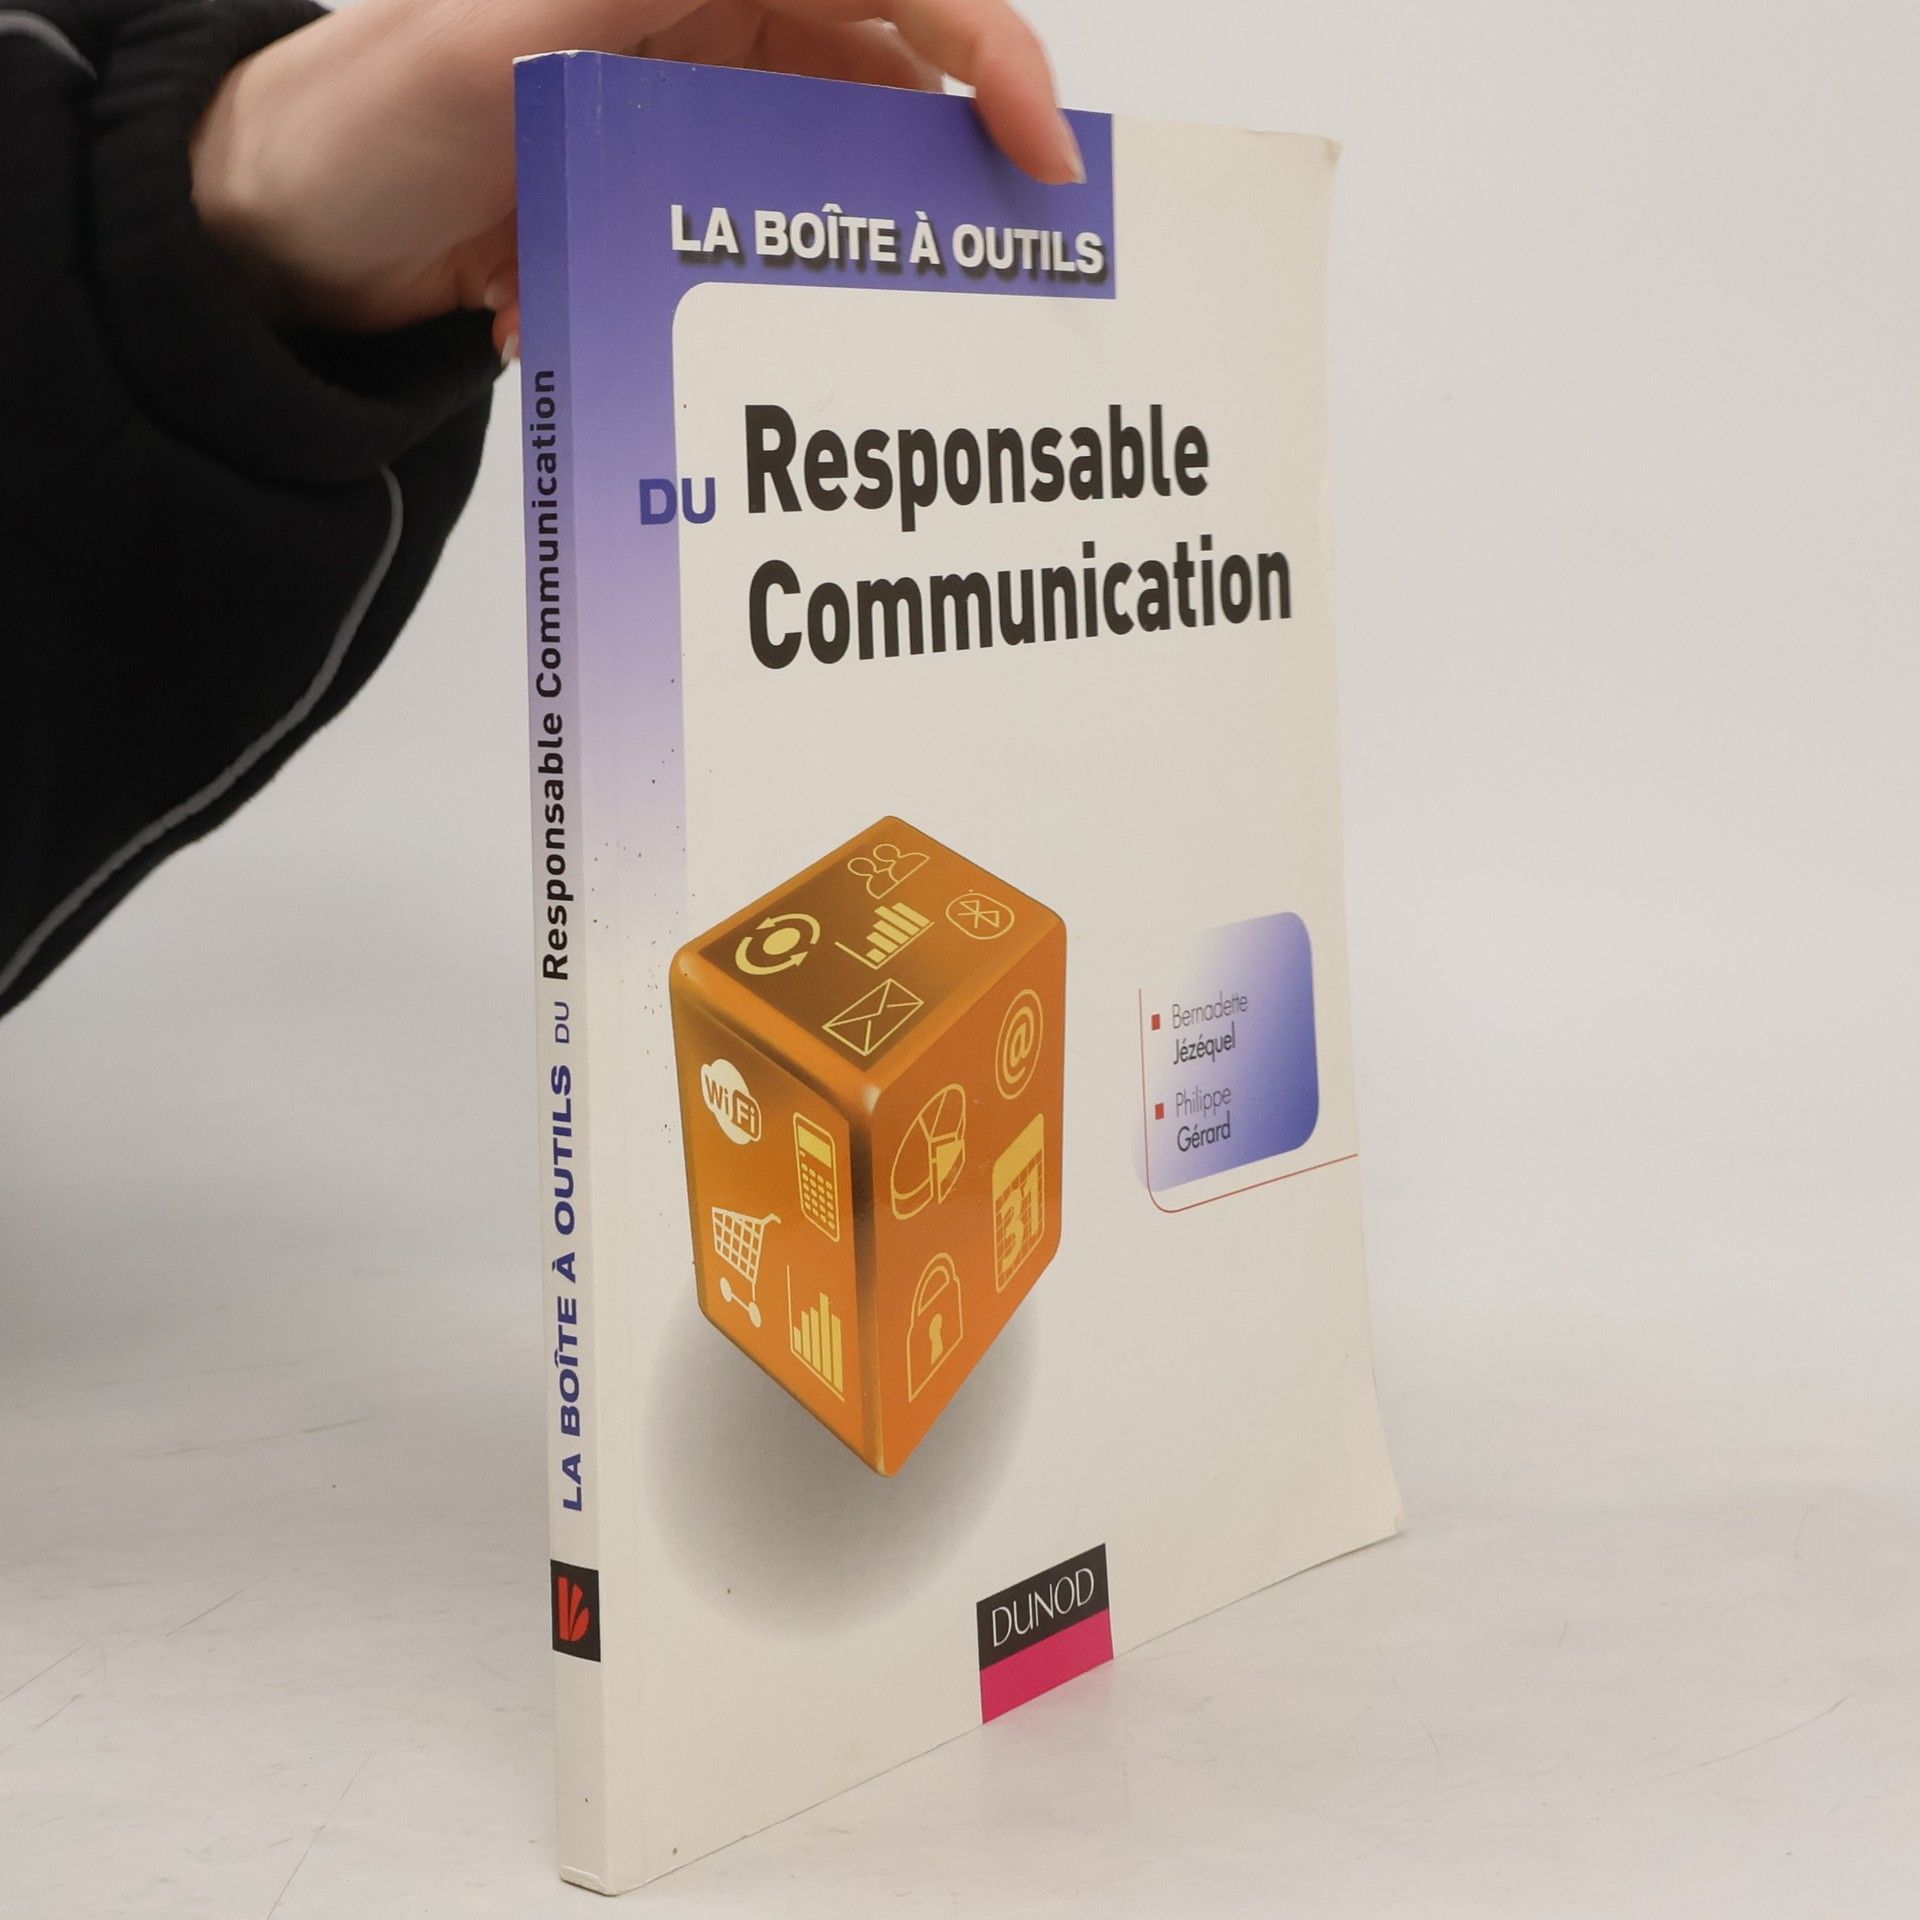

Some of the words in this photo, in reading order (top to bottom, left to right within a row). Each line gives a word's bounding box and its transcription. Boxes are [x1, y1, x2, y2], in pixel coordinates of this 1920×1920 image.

[670, 204, 740, 254] LA
[754, 203, 897, 263] BOÎTE
[909, 210, 941, 266] À
[952, 223, 1105, 275] OUTILS
[638, 477, 717, 526] DU
[745, 404, 1209, 532] Responsable
[530, 369, 562, 698] Communication
[748, 535, 1291, 669] Communication
[539, 712, 573, 980] Responsable
[554, 1002, 570, 1044] DU
[1171, 990, 1249, 1030] Bernadette
[1172, 1021, 1237, 1065] Jézéquel
[1175, 1085, 1232, 1118] Philippe
[1177, 1110, 1231, 1152] Gérard
[551, 1064, 575, 1235] OUTILS
[552, 1252, 576, 1284] À
[554, 1295, 581, 1437] BOÎTE
[562, 1453, 582, 1511] LA
[992, 1567, 1095, 1648] DUNOD
